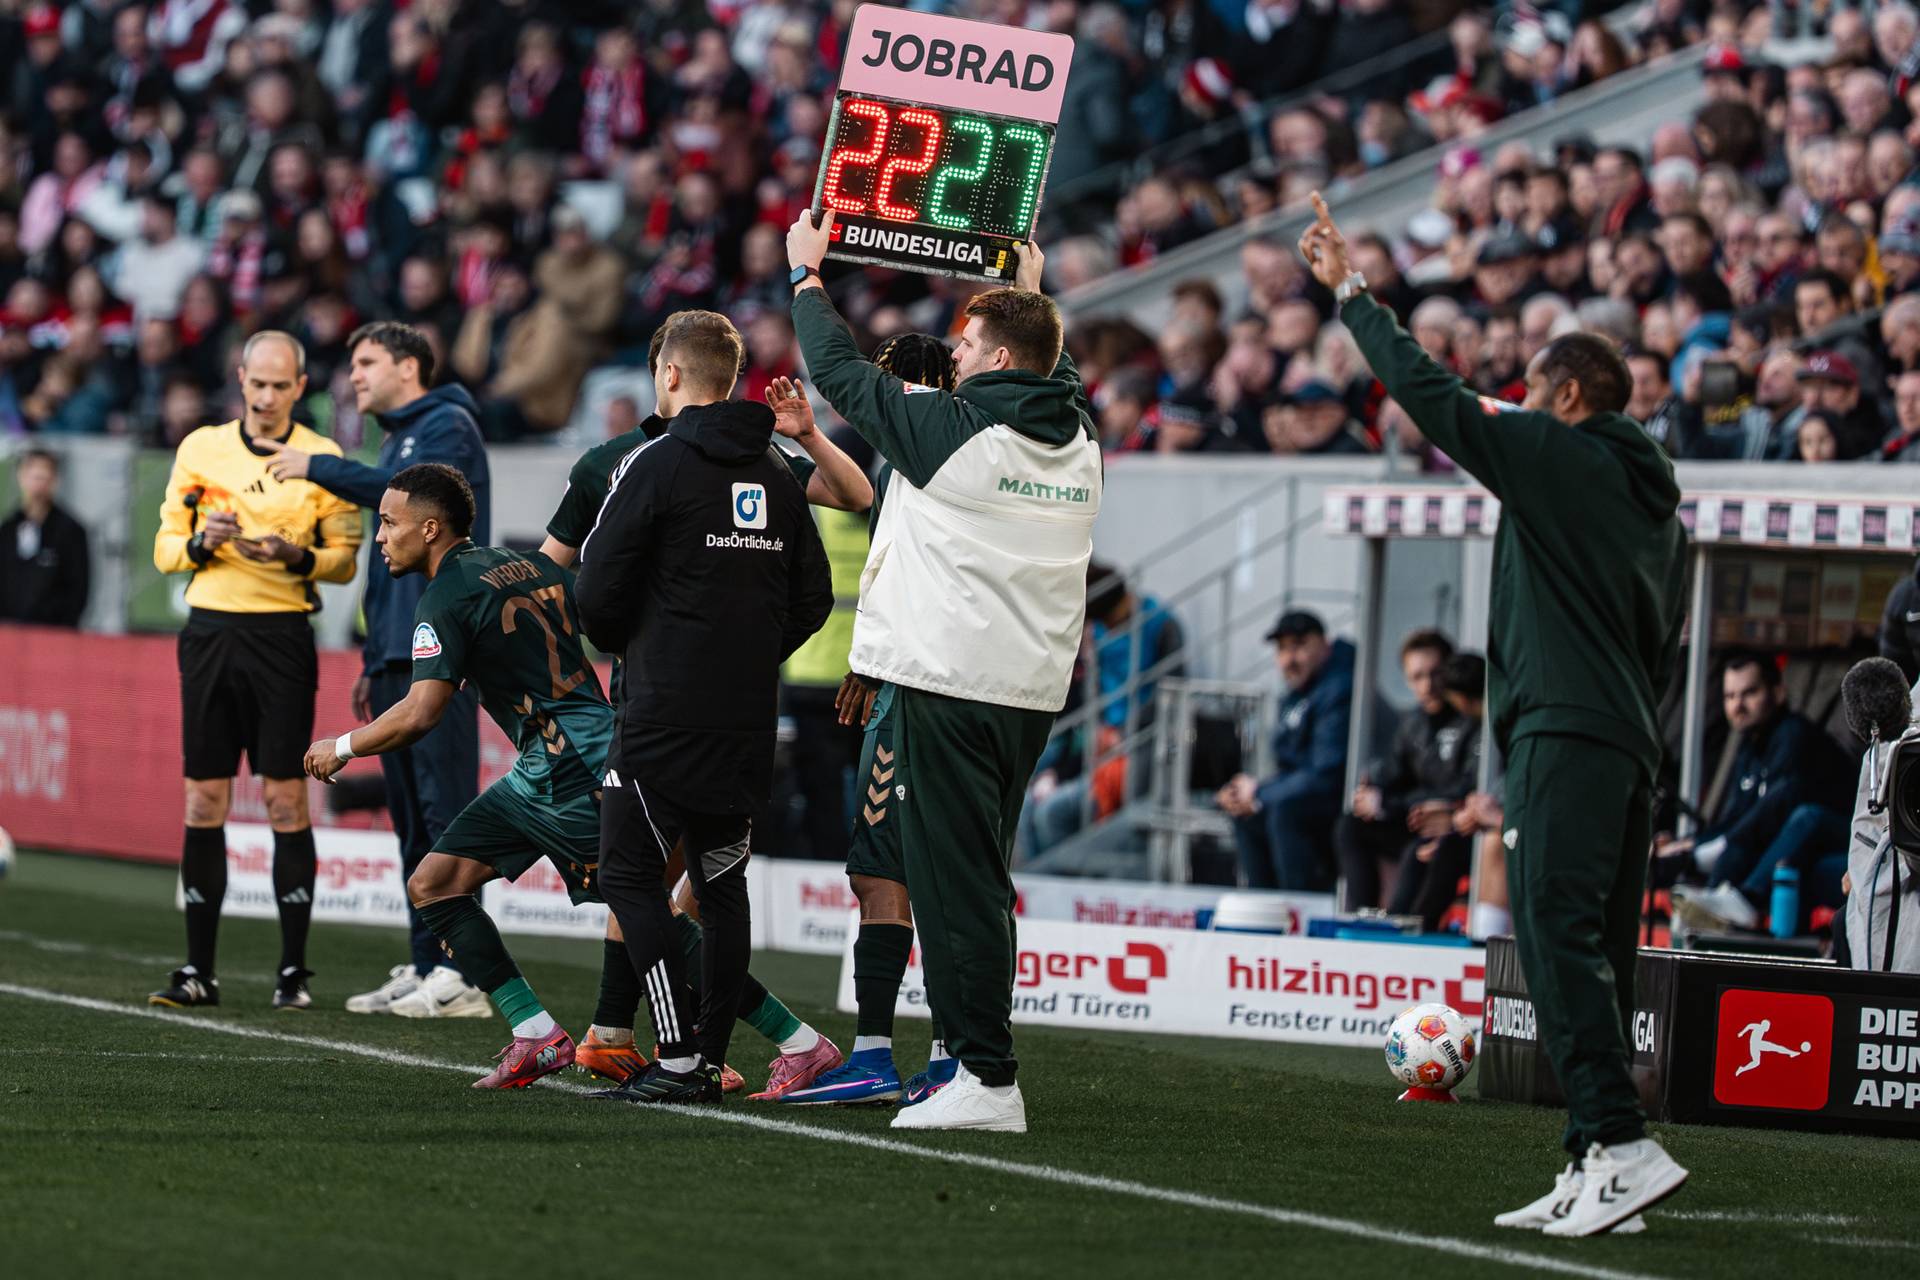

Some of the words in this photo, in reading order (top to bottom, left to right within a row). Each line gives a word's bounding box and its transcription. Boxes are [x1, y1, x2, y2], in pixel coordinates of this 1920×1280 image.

[862, 29, 1054, 92] JOBRAD
[825, 102, 941, 221] 22
[931, 119, 1045, 233] 27
[844, 225, 983, 265] BUNDESLIGA
[998, 477, 1090, 503] MATTHÄI
[706, 531, 783, 551] DasÖrtliche.de
[1228, 956, 1436, 1010] hilzinger
[1068, 992, 1151, 1018] Türen
[1229, 1004, 1335, 1034] Fenster
[1860, 1007, 1918, 1037] DIE
